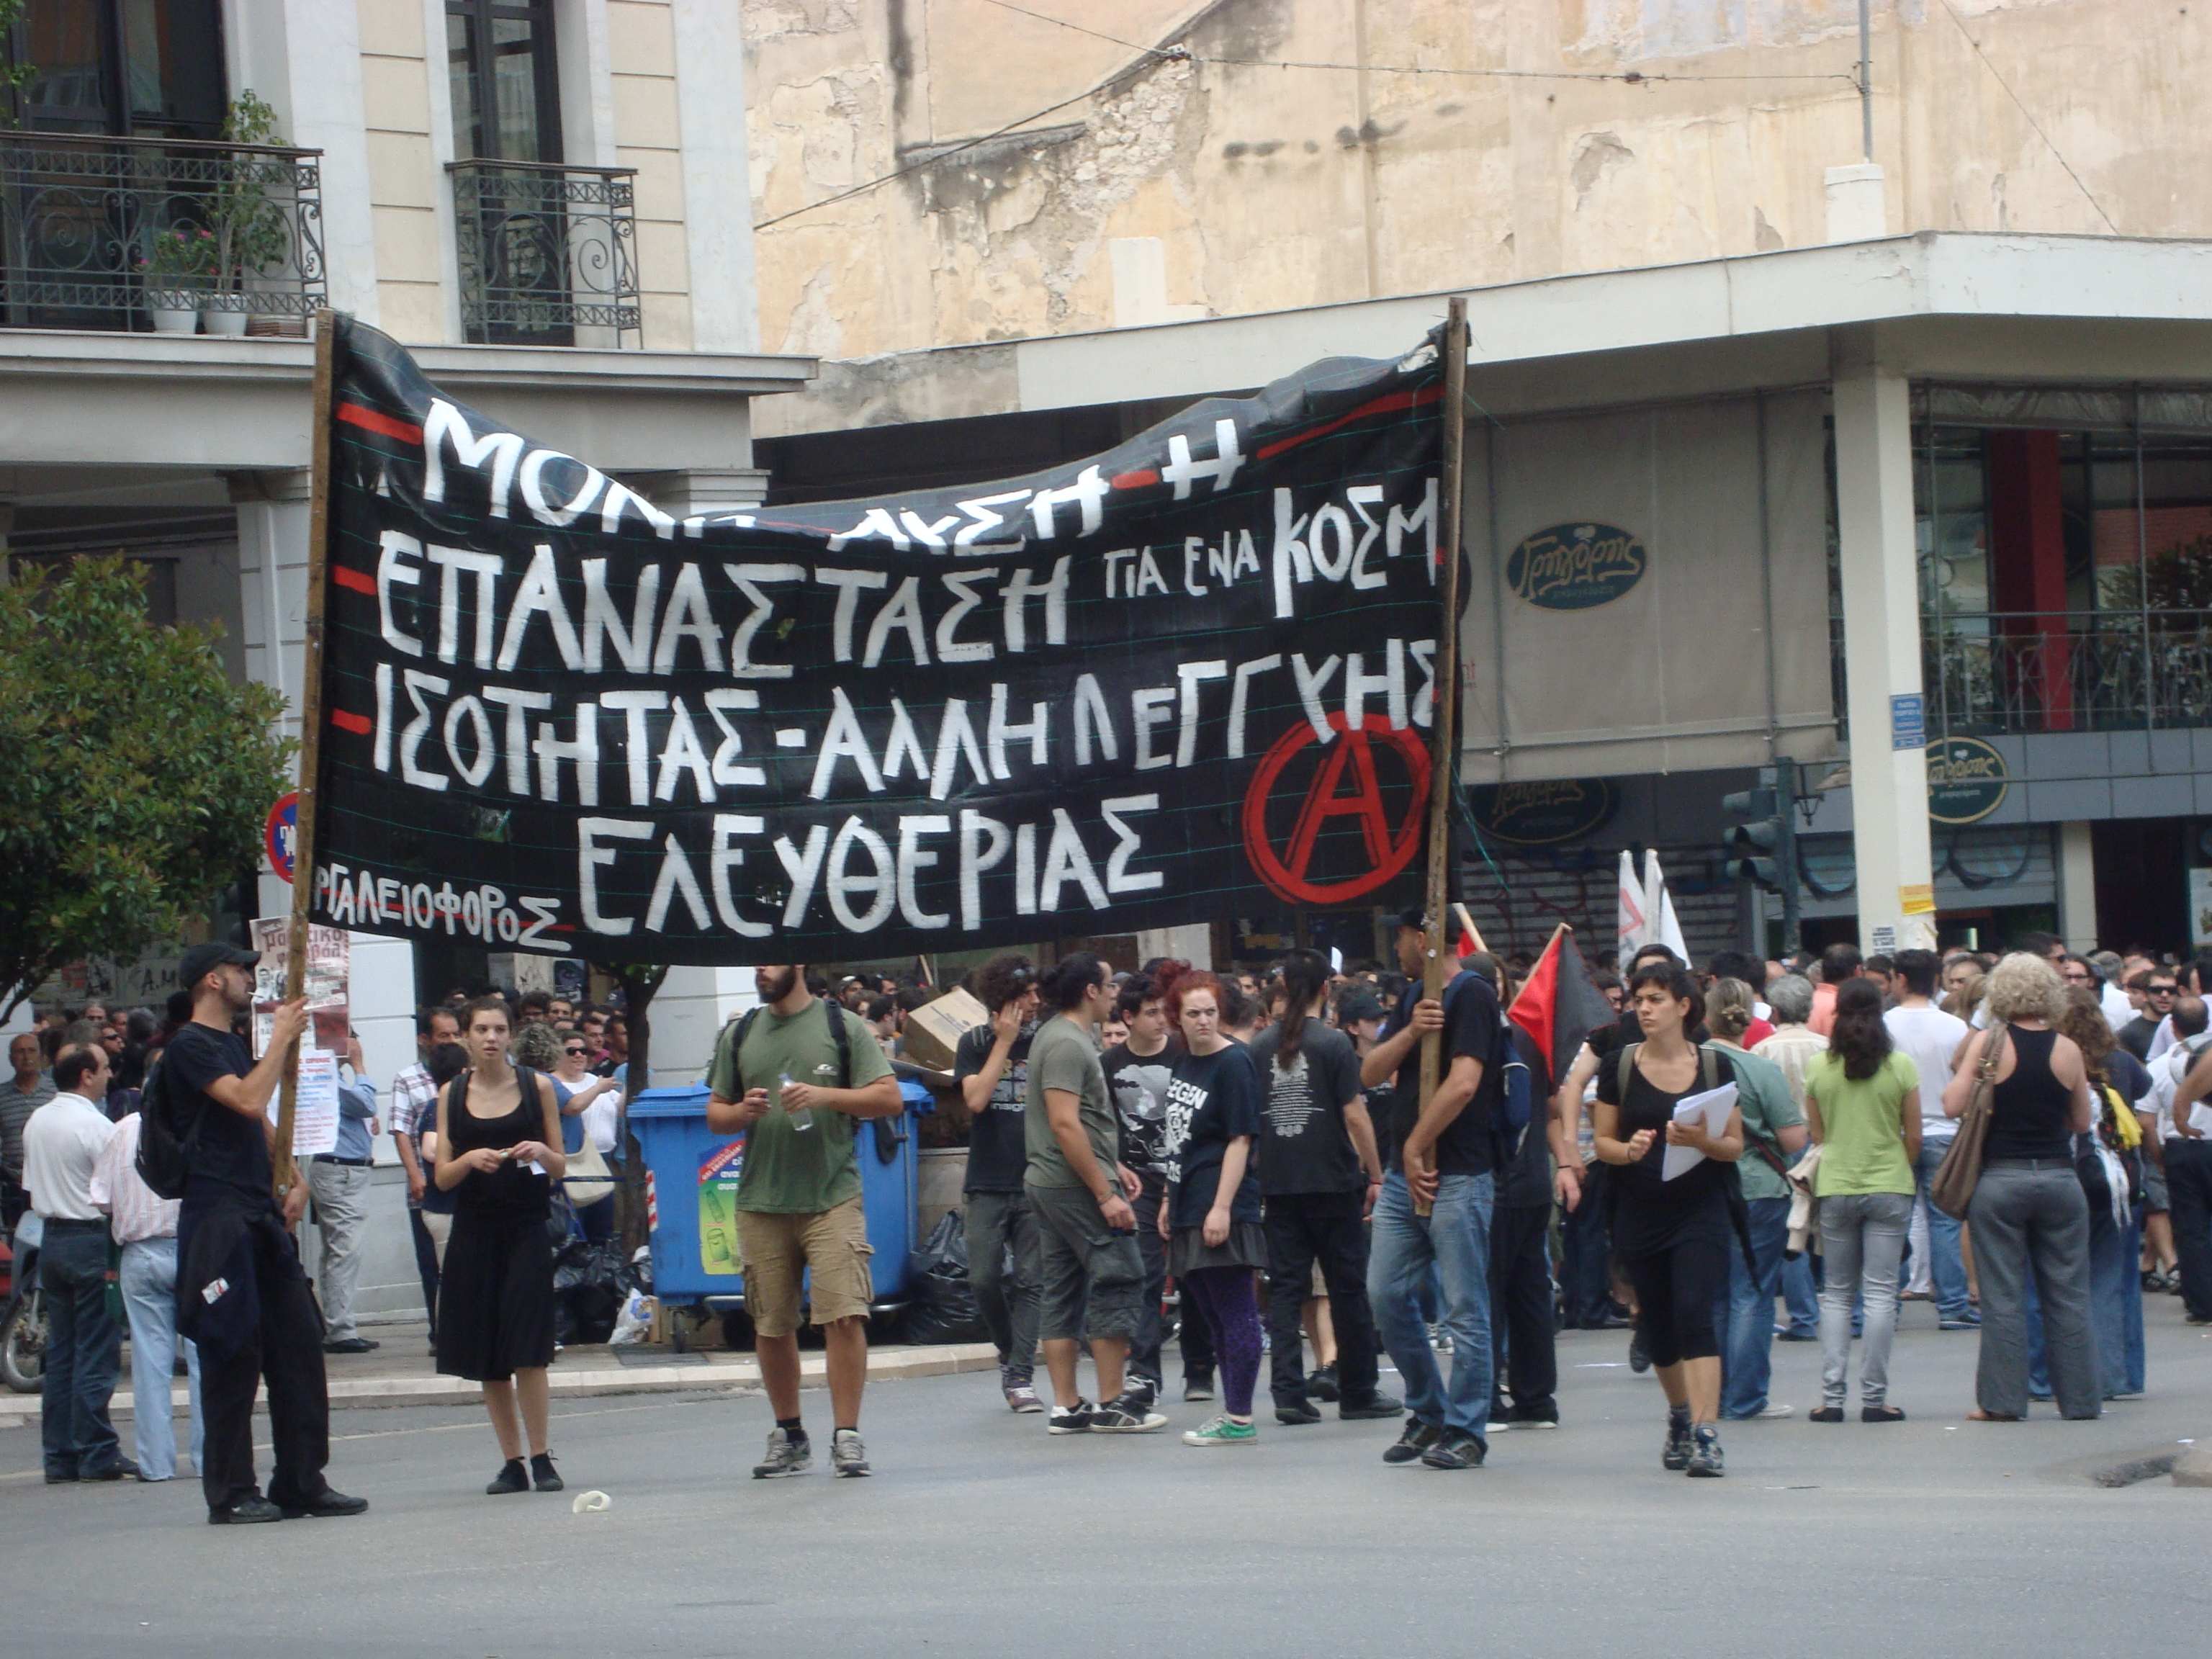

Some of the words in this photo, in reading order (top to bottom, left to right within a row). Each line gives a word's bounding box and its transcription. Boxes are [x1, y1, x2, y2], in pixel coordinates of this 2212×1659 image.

[377, 530, 1071, 678] ΕΠΑΝΑΣΤΑΣΗ
[1184, 529, 1260, 596] ΕΝΑ
[578, 793, 1164, 938] ΕΛΕΥΘΕΡΙΑΣ
